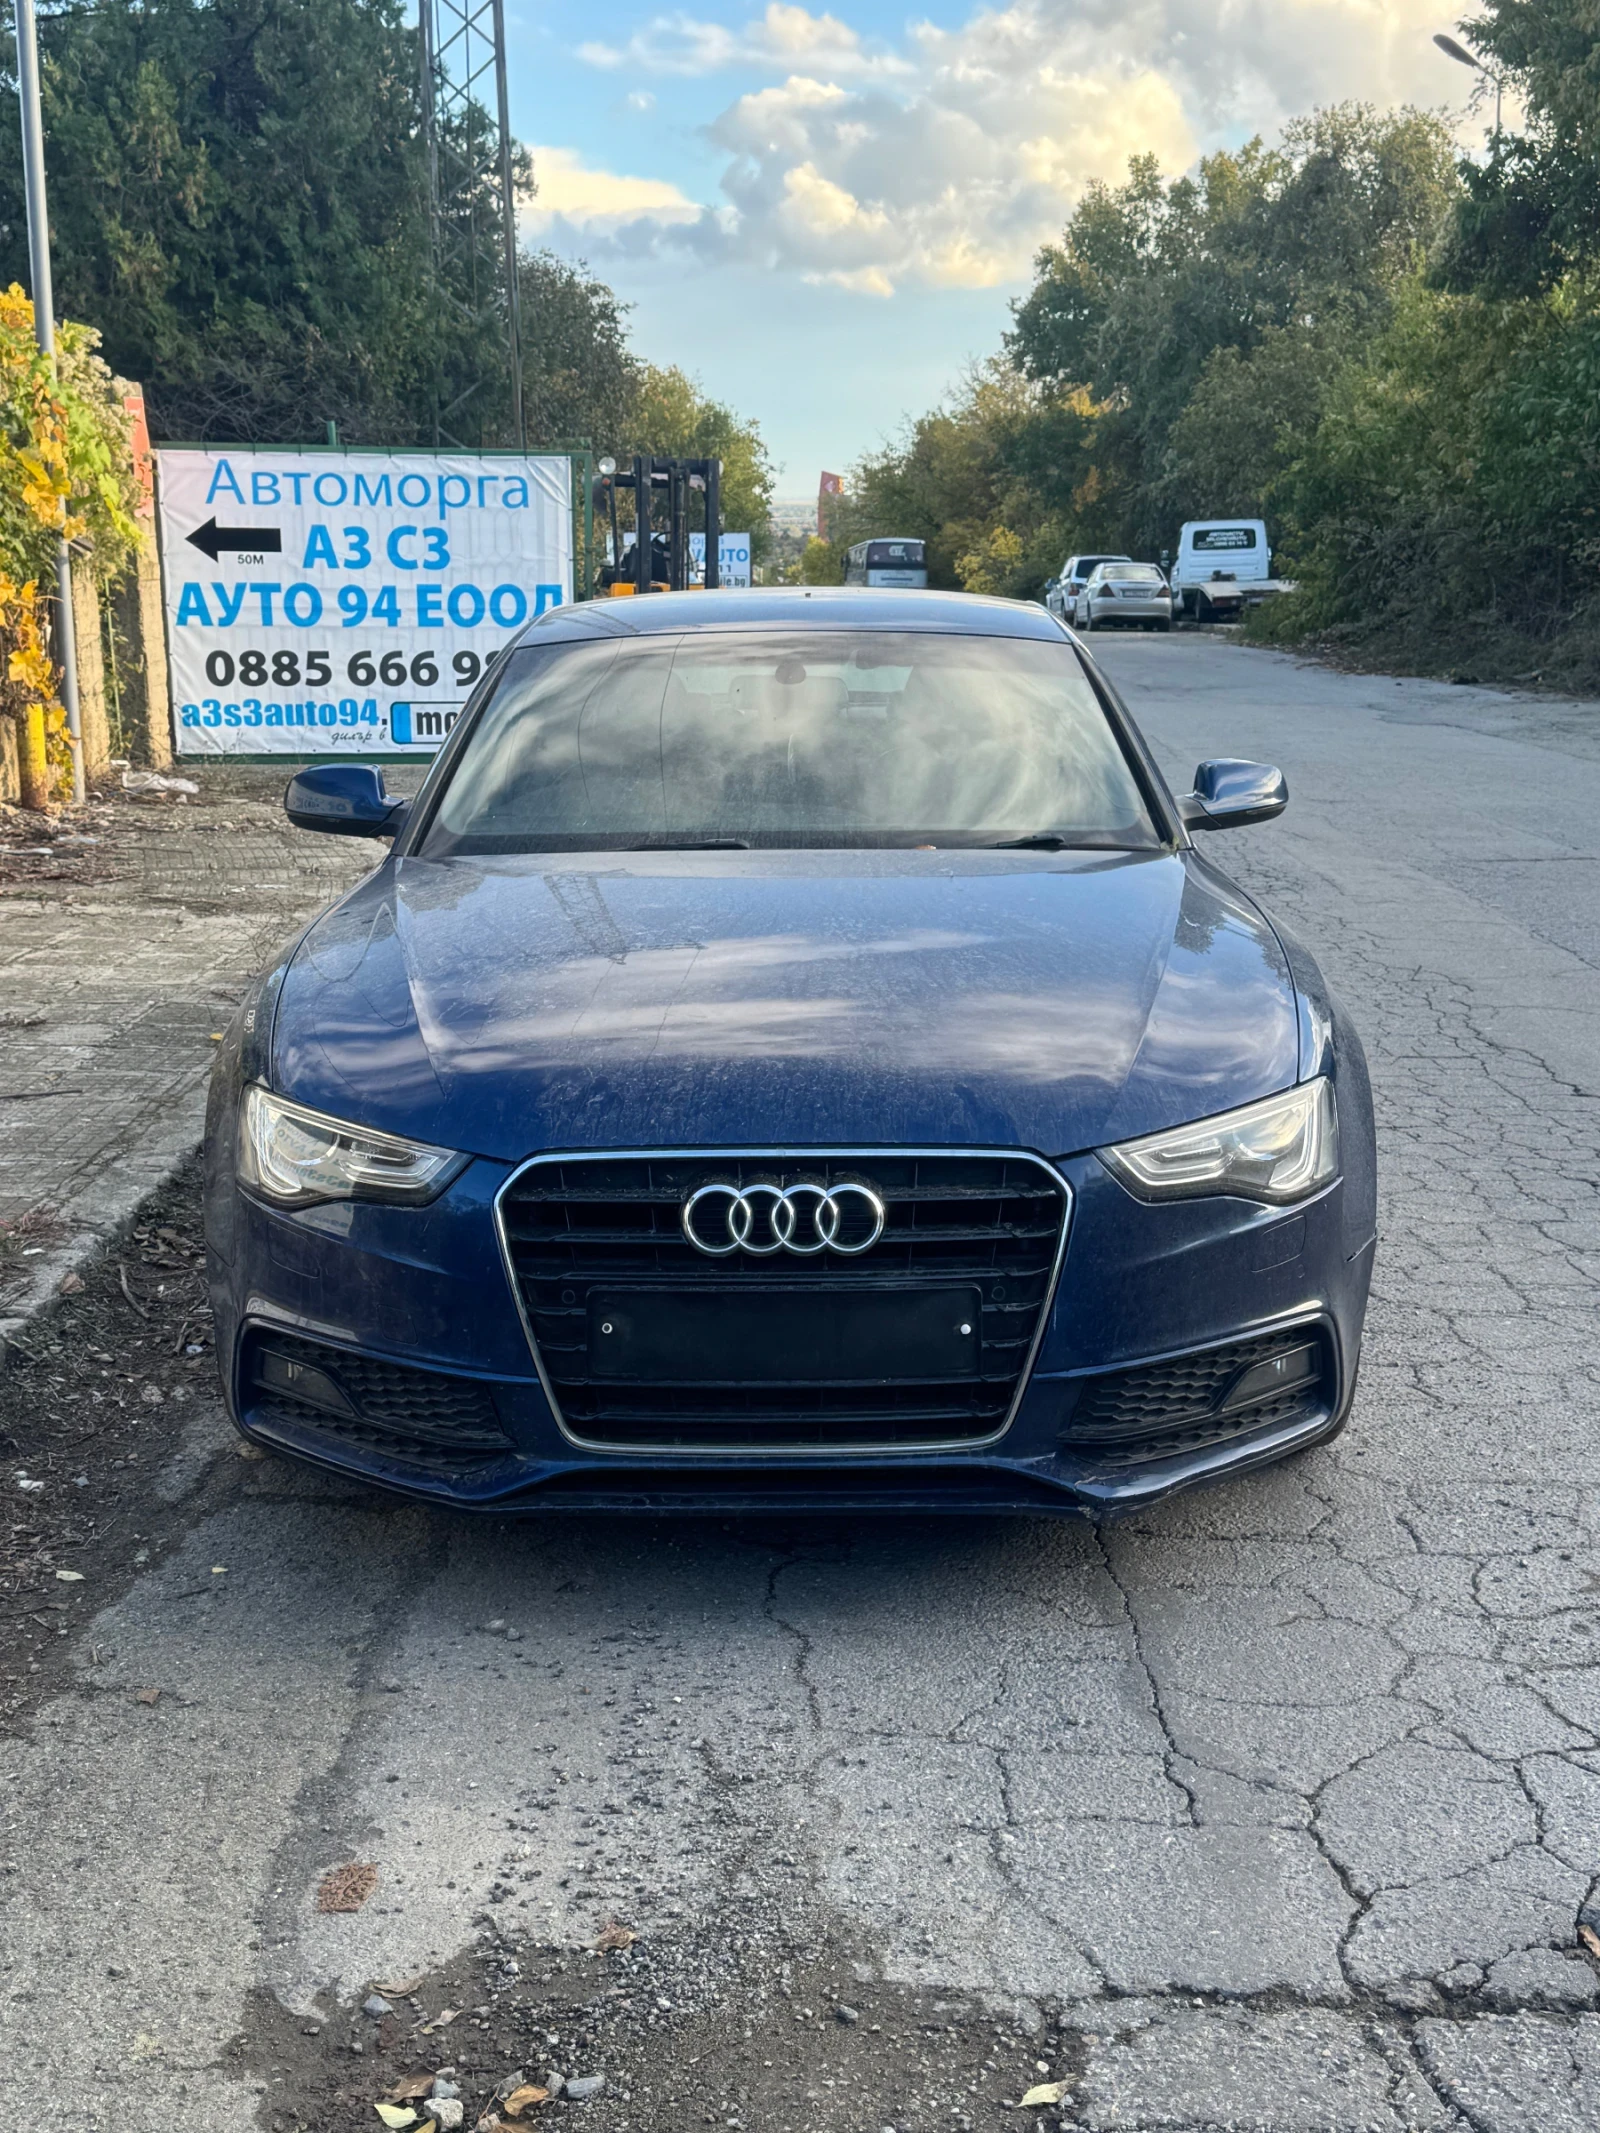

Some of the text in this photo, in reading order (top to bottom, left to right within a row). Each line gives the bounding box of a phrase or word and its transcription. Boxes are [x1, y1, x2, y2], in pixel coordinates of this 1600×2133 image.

[205, 458, 529, 520] Автоморга
[302, 524, 372, 570] А3
[175, 581, 323, 628] АУТО
[337, 584, 402, 628] 94
[205, 650, 499, 687] 0885 666 9
